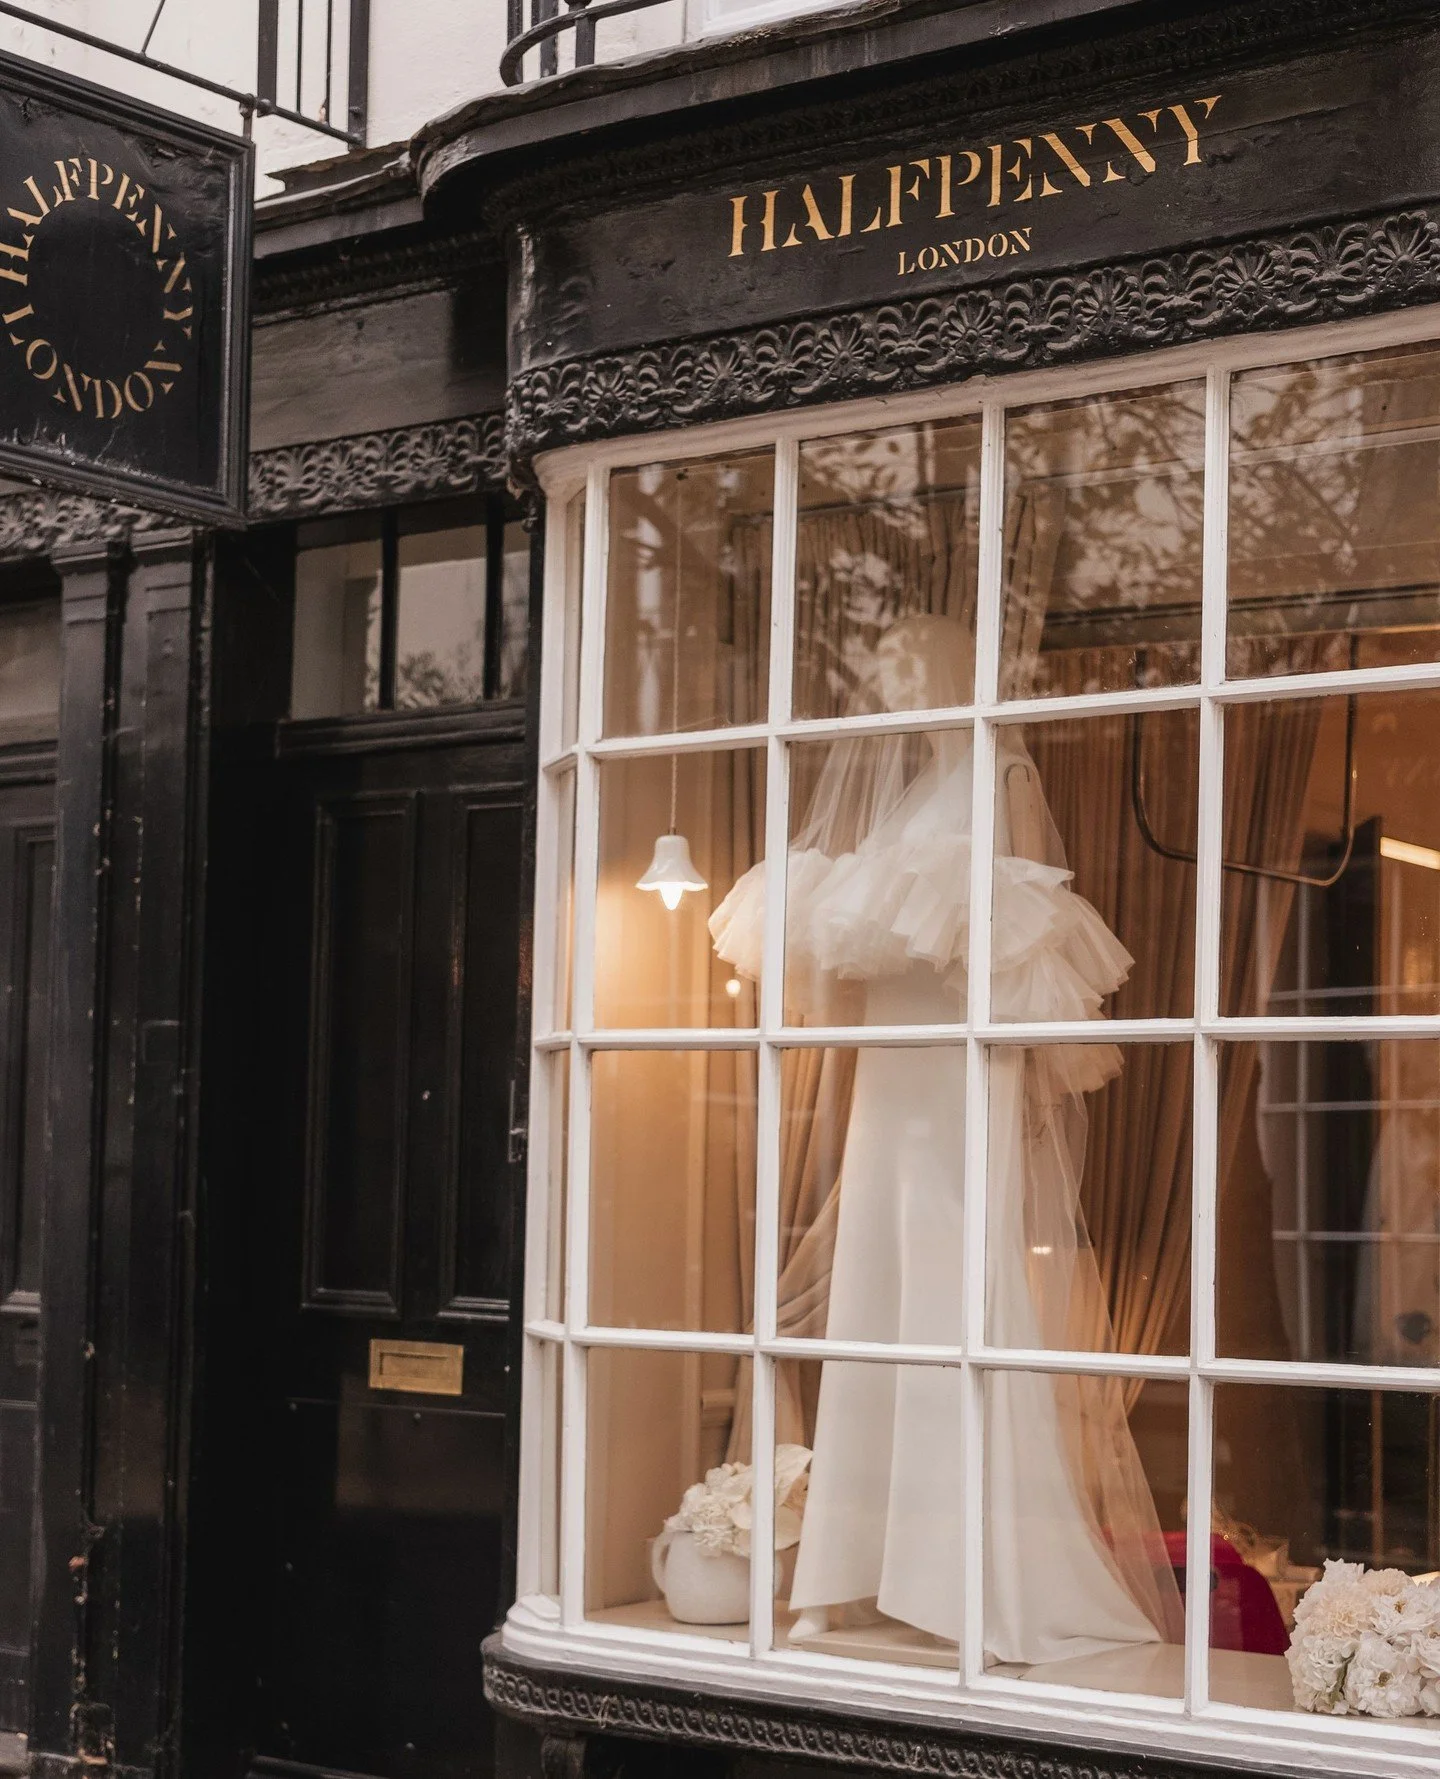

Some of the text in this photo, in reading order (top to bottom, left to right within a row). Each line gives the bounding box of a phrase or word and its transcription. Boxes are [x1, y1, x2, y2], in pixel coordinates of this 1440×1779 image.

[728, 94, 1222, 257] HALFPENNY
[0, 157, 193, 339] HALFPENNY
[897, 226, 1033, 277] LONDON
[2, 303, 183, 419] LONDON
